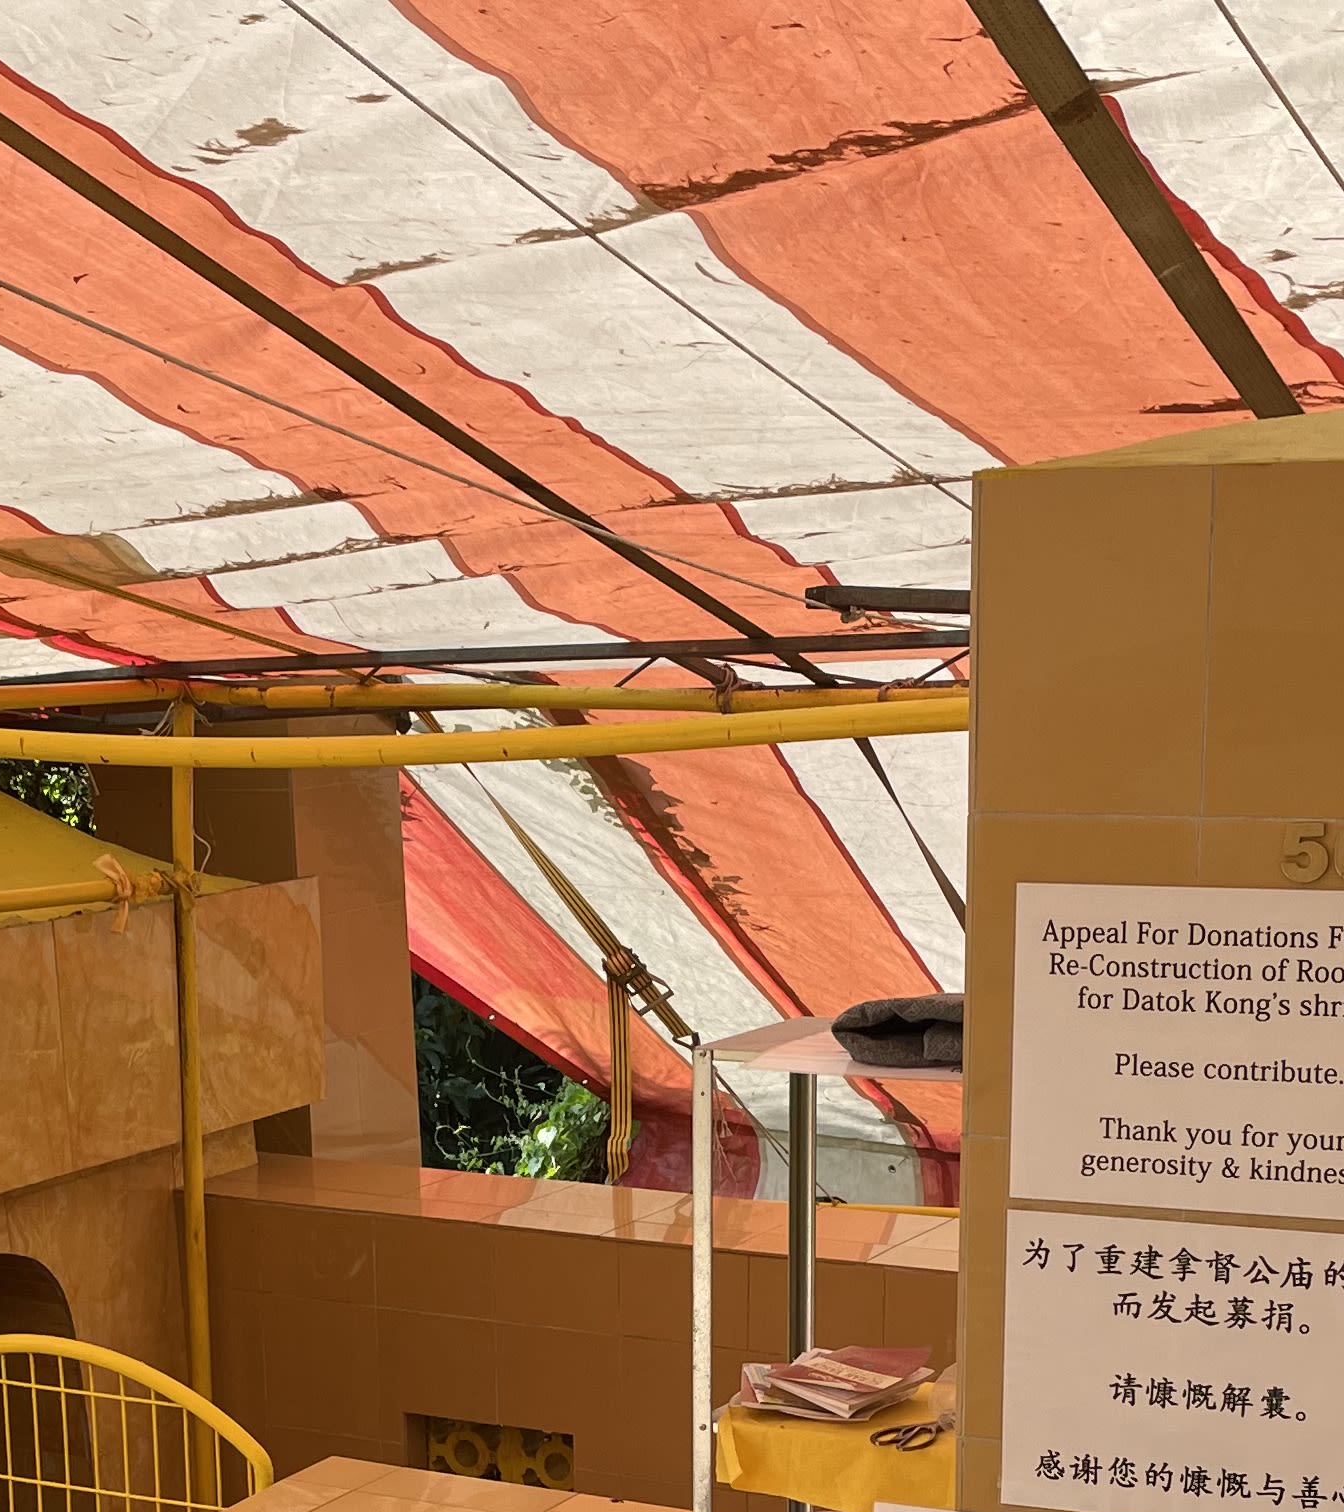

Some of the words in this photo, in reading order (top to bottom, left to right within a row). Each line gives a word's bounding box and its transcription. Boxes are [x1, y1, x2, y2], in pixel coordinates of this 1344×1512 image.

[1042, 920, 1128, 948] Appeal
[1137, 921, 1179, 945] For
[1187, 923, 1319, 950] Donations
[1049, 953, 1252, 982] Re-Construction
[1261, 958, 1289, 983] of
[1077, 987, 1113, 1010] for
[1122, 988, 1196, 1013] Datok
[1204, 991, 1291, 1022] Kong's
[1114, 1053, 1194, 1079] Please
[1204, 1059, 1344, 1085] contribute.
[1100, 1117, 1177, 1143] Thank
[1186, 1126, 1232, 1149] you
[1241, 1124, 1278, 1148] for
[1081, 1152, 1212, 1183] generosity
[1221, 1157, 1240, 1179] &
[1111, 1290, 1311, 1337] 而发起募捐。
[1109, 1372, 1309, 1423] 请慷慨解囊。
